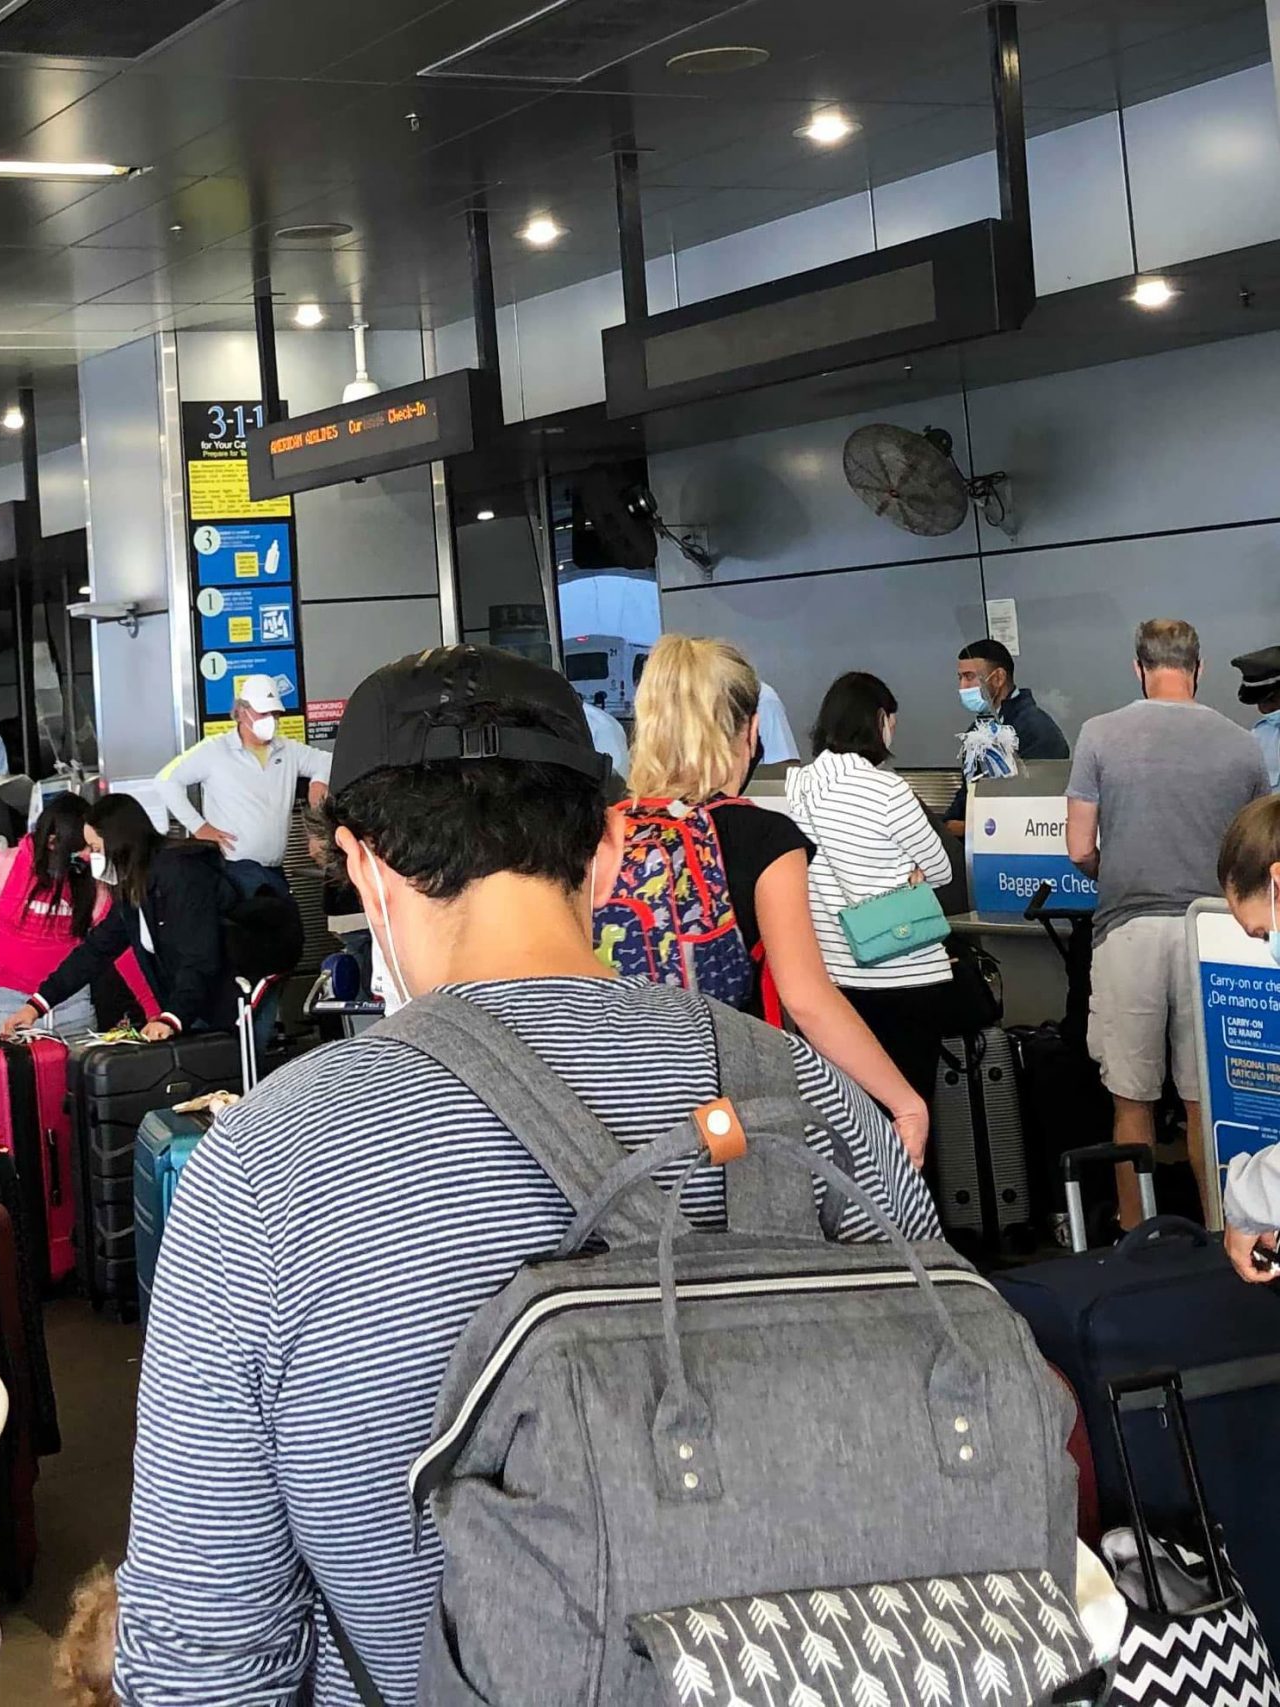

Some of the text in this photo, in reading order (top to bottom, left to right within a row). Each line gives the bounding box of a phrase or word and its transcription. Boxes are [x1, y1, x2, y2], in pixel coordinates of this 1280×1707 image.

[208, 405, 263, 439] 3-1-1
[201, 440, 248, 449] for Your Ca
[203, 530, 213, 550] 3
[208, 594, 214, 611] 1
[210, 658, 217, 675] 1
[1061, 874, 1098, 894] Chec
[1210, 973, 1251, 991] Carry-on
[1253, 980, 1263, 990] or
[1228, 995, 1258, 1009] mano
[1260, 999, 1267, 1010] o
[1227, 1017, 1263, 1029] CARRY-ON
[1228, 1027, 1262, 1039] DE MANO
[1230, 1057, 1265, 1071] PERSONAL
